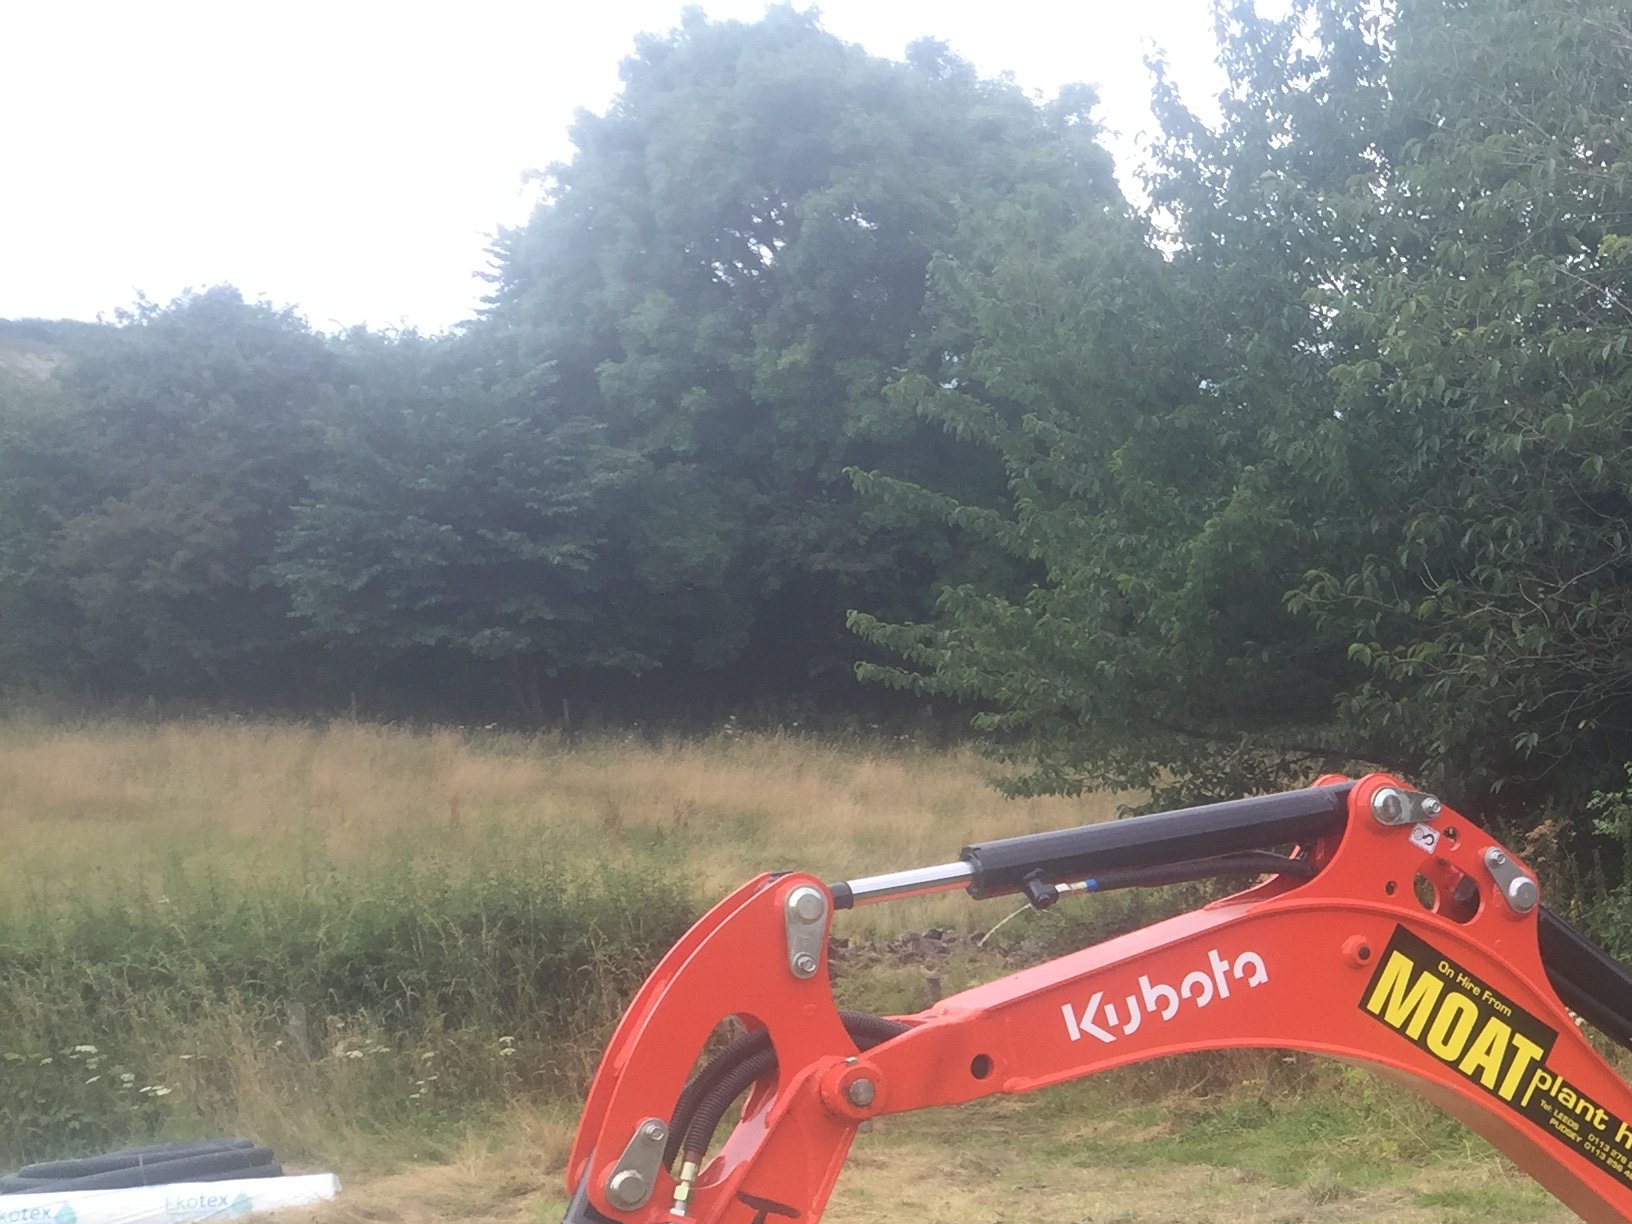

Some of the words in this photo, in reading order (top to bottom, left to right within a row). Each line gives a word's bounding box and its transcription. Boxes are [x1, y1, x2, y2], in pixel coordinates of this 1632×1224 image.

[1061, 949, 1268, 1043] Kubota
[1437, 960, 1455, 979] On
[1456, 972, 1481, 996] Hire
[1482, 990, 1513, 1017] From
[1366, 950, 1545, 1102] MOAT
[1521, 1068, 1610, 1131] plant
[1549, 1117, 1583, 1143] PUDSEY
[1553, 1109, 1580, 1131] LEEDS
[1587, 1133, 1611, 1153] 0113
[165, 1194, 228, 1213] Ekotex
